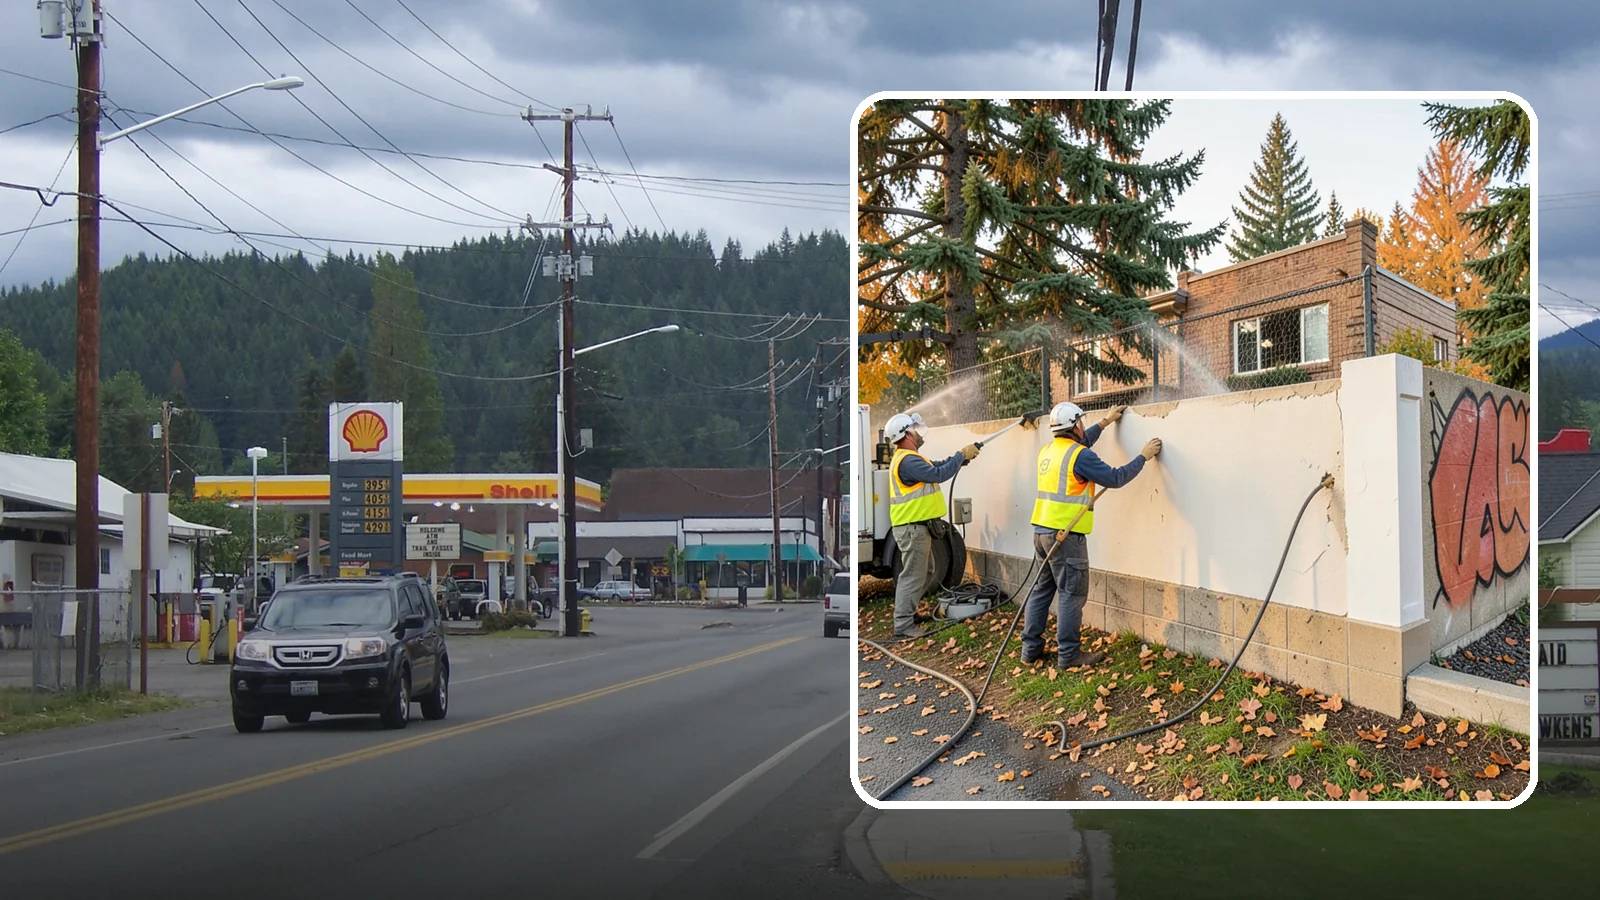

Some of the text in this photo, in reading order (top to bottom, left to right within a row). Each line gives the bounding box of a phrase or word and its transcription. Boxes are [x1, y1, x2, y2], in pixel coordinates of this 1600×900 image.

[366, 480, 383, 490] 395
[490, 484, 547, 499] Shell
[366, 494, 383, 504] 405
[366, 508, 383, 518] 415
[366, 522, 383, 532] 429
[1539, 643, 1567, 665] AID
